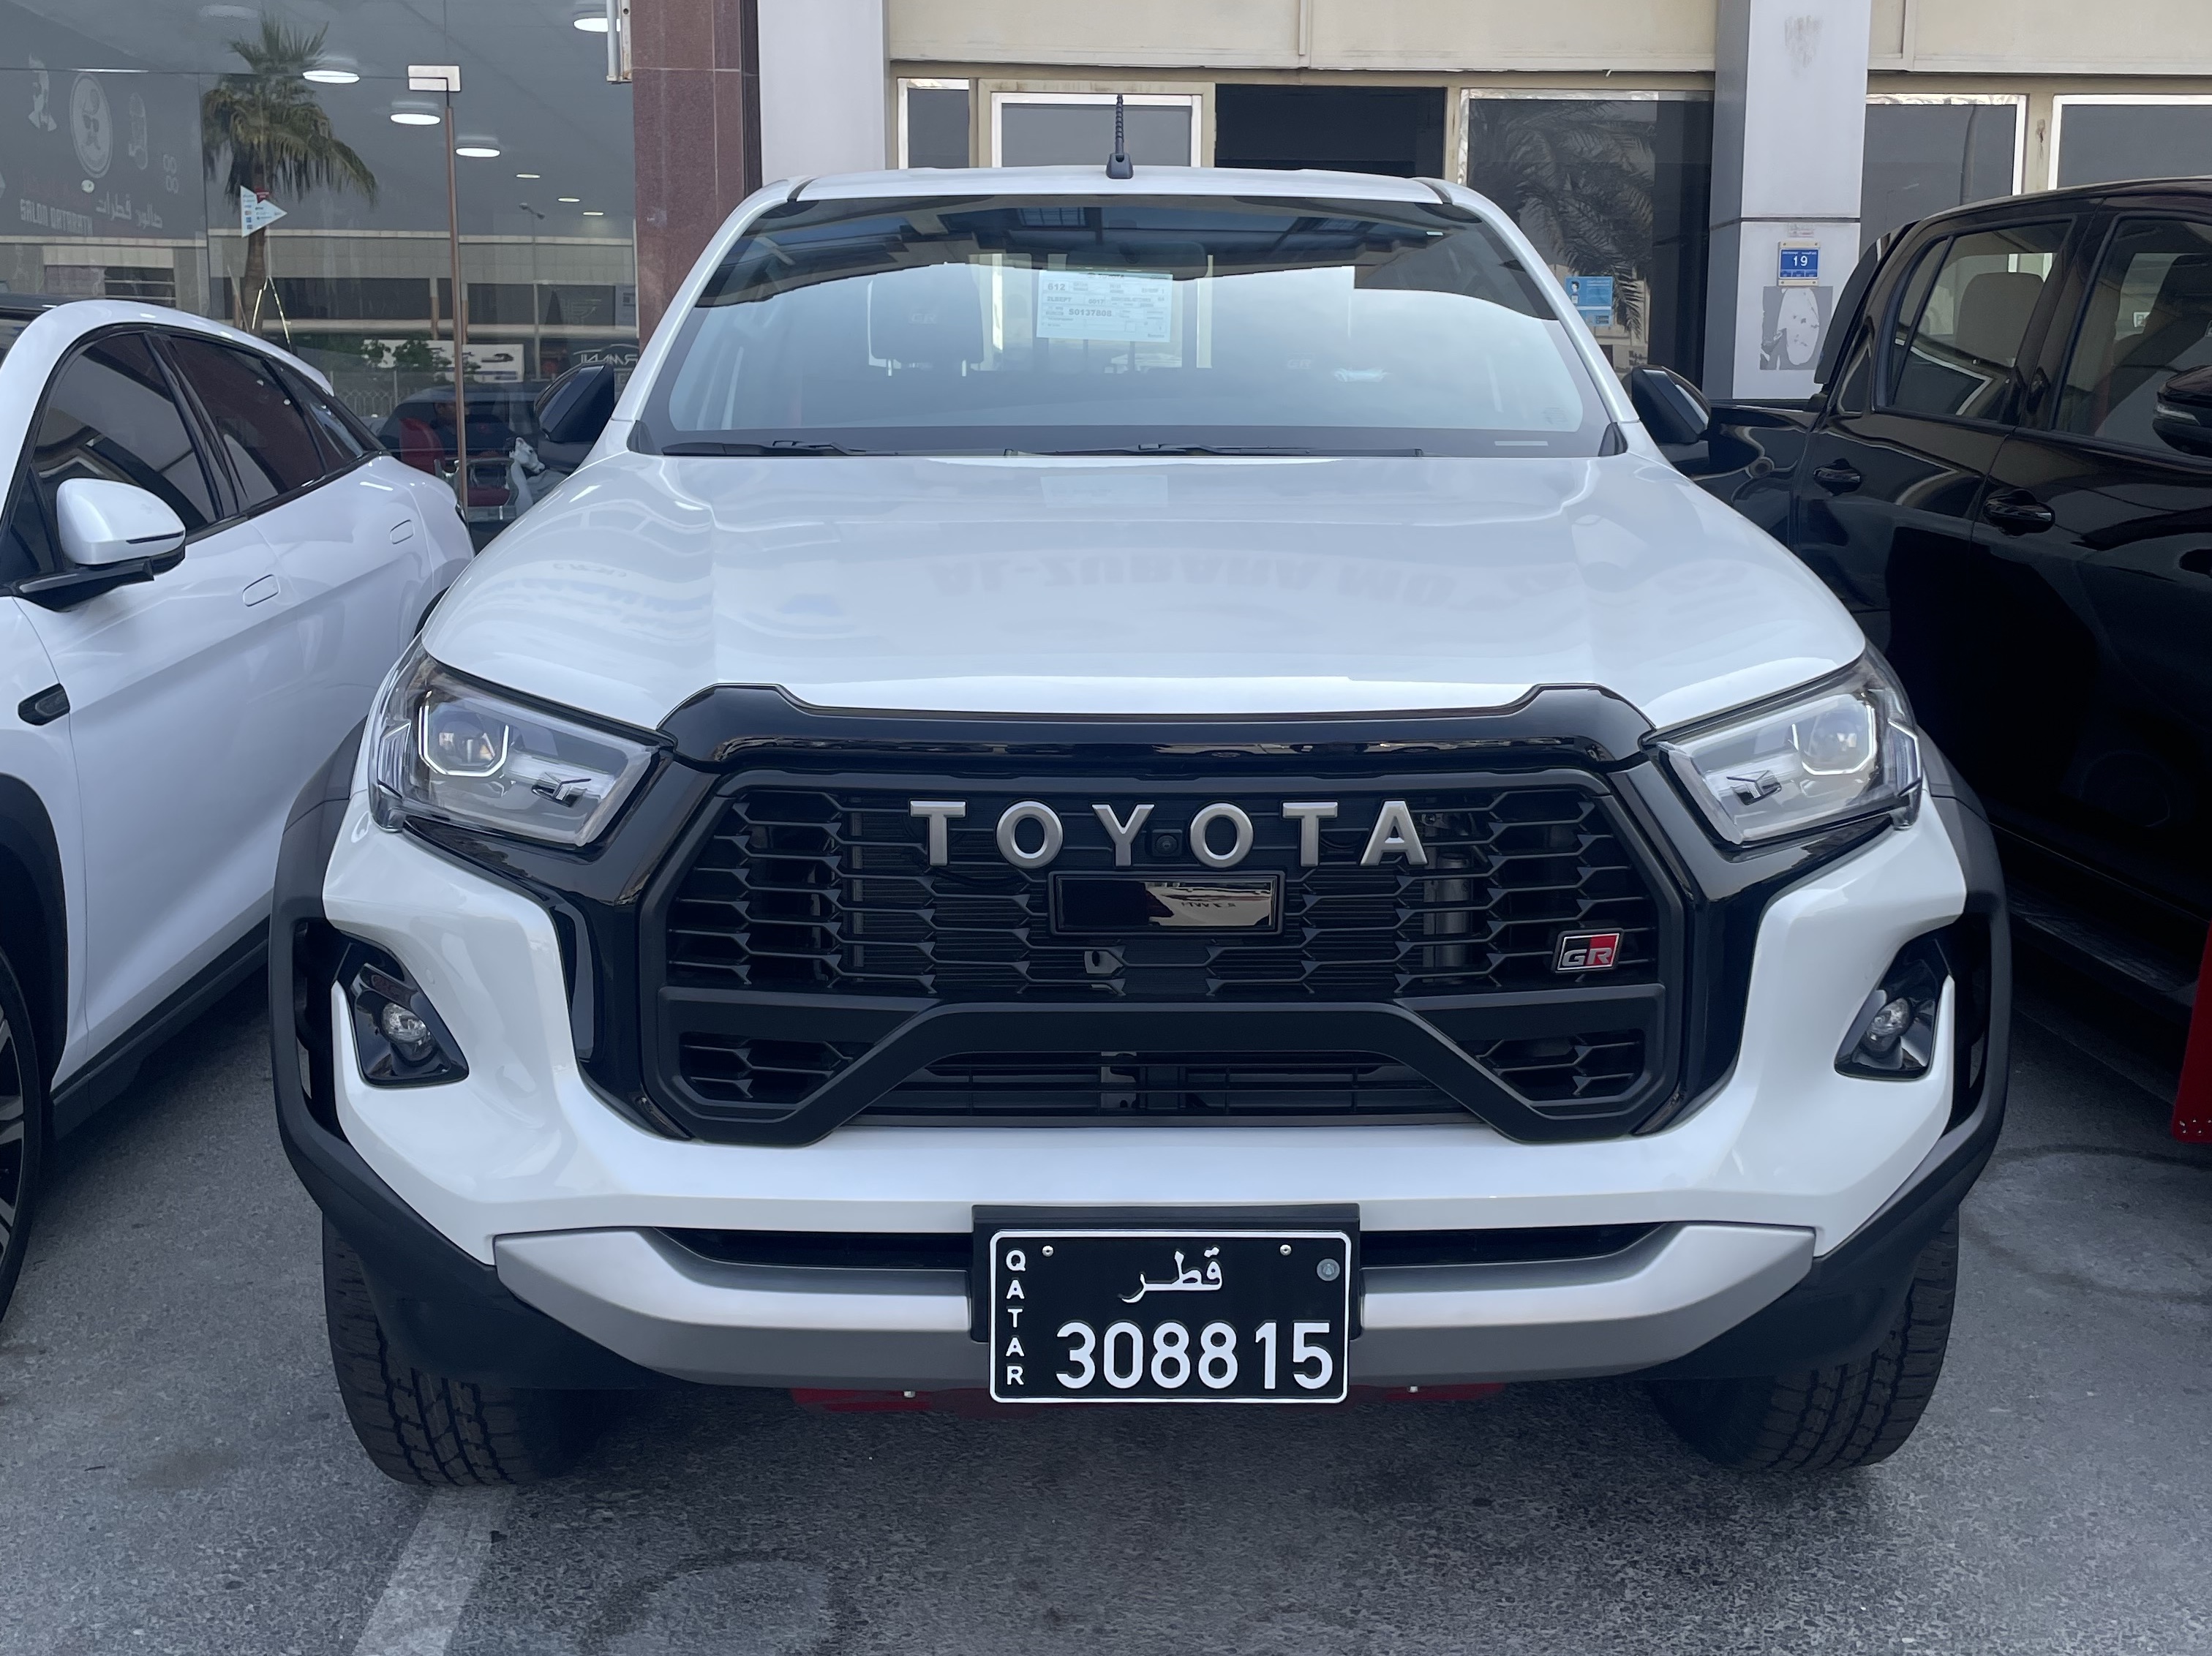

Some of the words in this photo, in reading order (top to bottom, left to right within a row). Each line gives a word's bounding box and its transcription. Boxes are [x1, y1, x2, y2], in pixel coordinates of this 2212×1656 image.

[1793, 255, 1807, 266] 19
[910, 800, 1427, 868] TOYOTA
[1562, 947, 1612, 967] GR
[1119, 1247, 1223, 1303] قطر
[1006, 1249, 1026, 1385] QATAR
[1056, 1322, 1333, 1389] 308815
